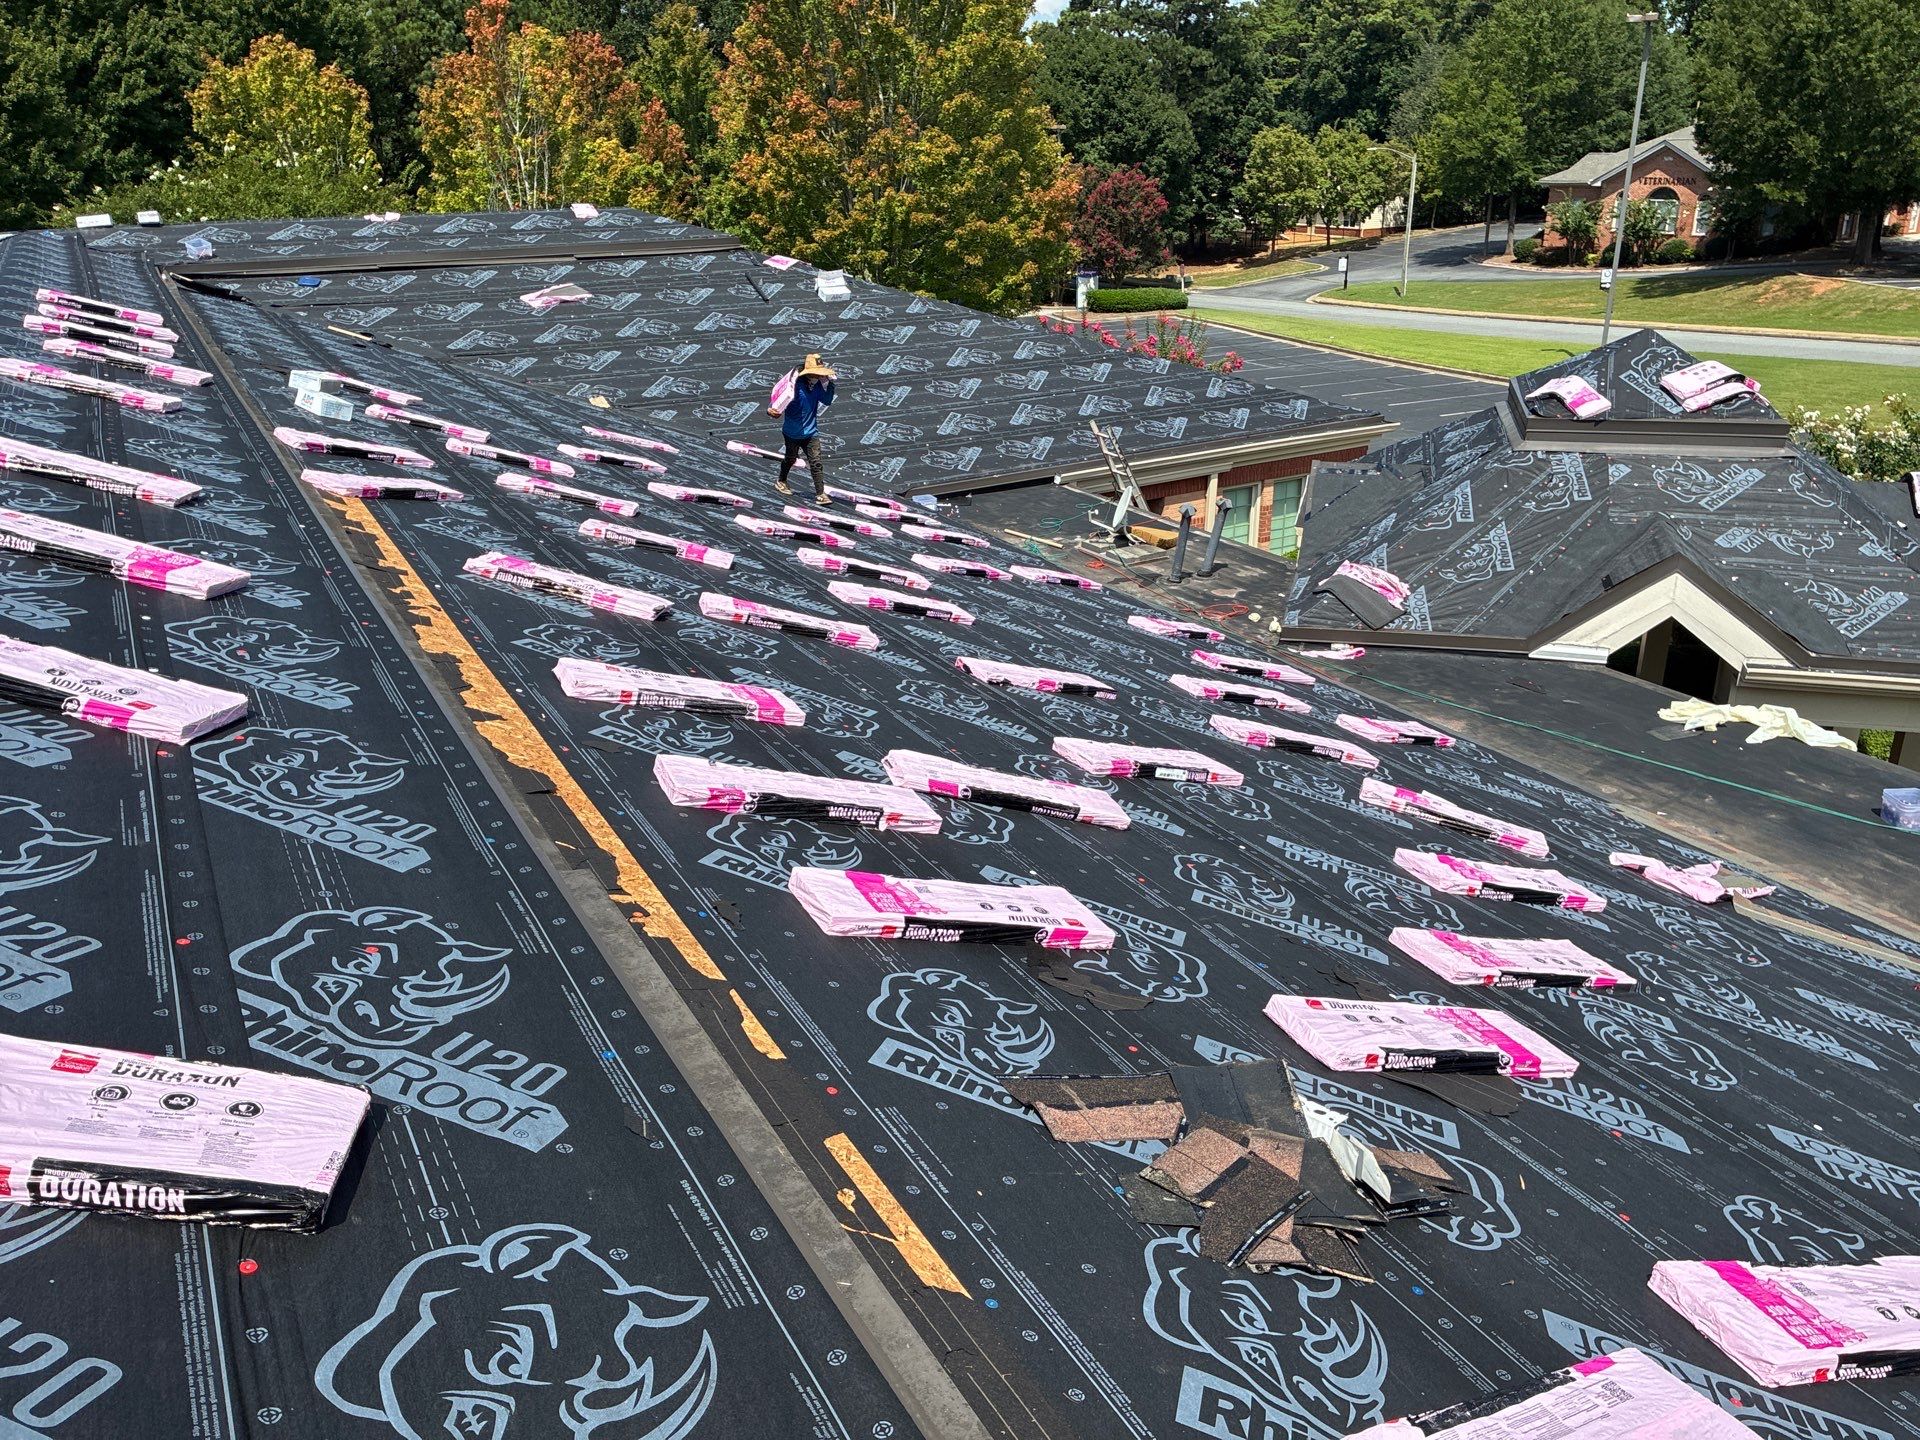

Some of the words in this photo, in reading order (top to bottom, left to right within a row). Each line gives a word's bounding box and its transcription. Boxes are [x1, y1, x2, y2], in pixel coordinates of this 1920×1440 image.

[1639, 177, 1697, 186] VETERINARIAN
[1624, 372, 1679, 413] RhinoRoof
[1550, 454, 1565, 472] U20
[1718, 464, 1744, 482] U20
[1704, 470, 1762, 509] RhinoRoof
[1736, 534, 1765, 554] U20
[497, 572, 534, 588] DURATION
[1856, 585, 1885, 606] U20
[1844, 592, 1905, 636] RhinoRoof
[279, 659, 360, 694] U20
[640, 693, 686, 708] DURATION
[905, 698, 1032, 739] RhinoRoof
[980, 714, 1028, 732] U20
[1032, 806, 1074, 820] DURATION
[1119, 799, 1168, 821] U20
[334, 804, 437, 842] U20
[1276, 840, 1424, 894] RhinoRoof
[1284, 850, 1339, 874] U20
[1008, 915, 1061, 926] DURATION
[1201, 893, 1376, 957] RhinoRoof
[1300, 914, 1364, 943] U20
[906, 927, 964, 942] DURATION
[1772, 1016, 1838, 1045] U20
[432, 1032, 568, 1096] U20
[1385, 1055, 1436, 1068] DURATION
[1564, 1078, 1647, 1118] U20
[1813, 1156, 1901, 1200] U20
[38, 1174, 186, 1212] DURATION
[679, 1177, 714, 1227] 1-800-438-7465
[176, 1281, 185, 1300] footwear
[179, 1300, 187, 1319] weather,
[181, 1320, 190, 1345] conditions,
[182, 1345, 191, 1364] surface
[185, 1364, 193, 1374] with
[186, 1375, 195, 1386] vary
[196, 1375, 205, 1395] acuerdo
[188, 1386, 196, 1397] may
[189, 1398, 199, 1425] resistance
[798, 1391, 820, 1417] pendiente
[191, 1425, 201, 1437] Slip
[201, 1419, 210, 1436] puede
